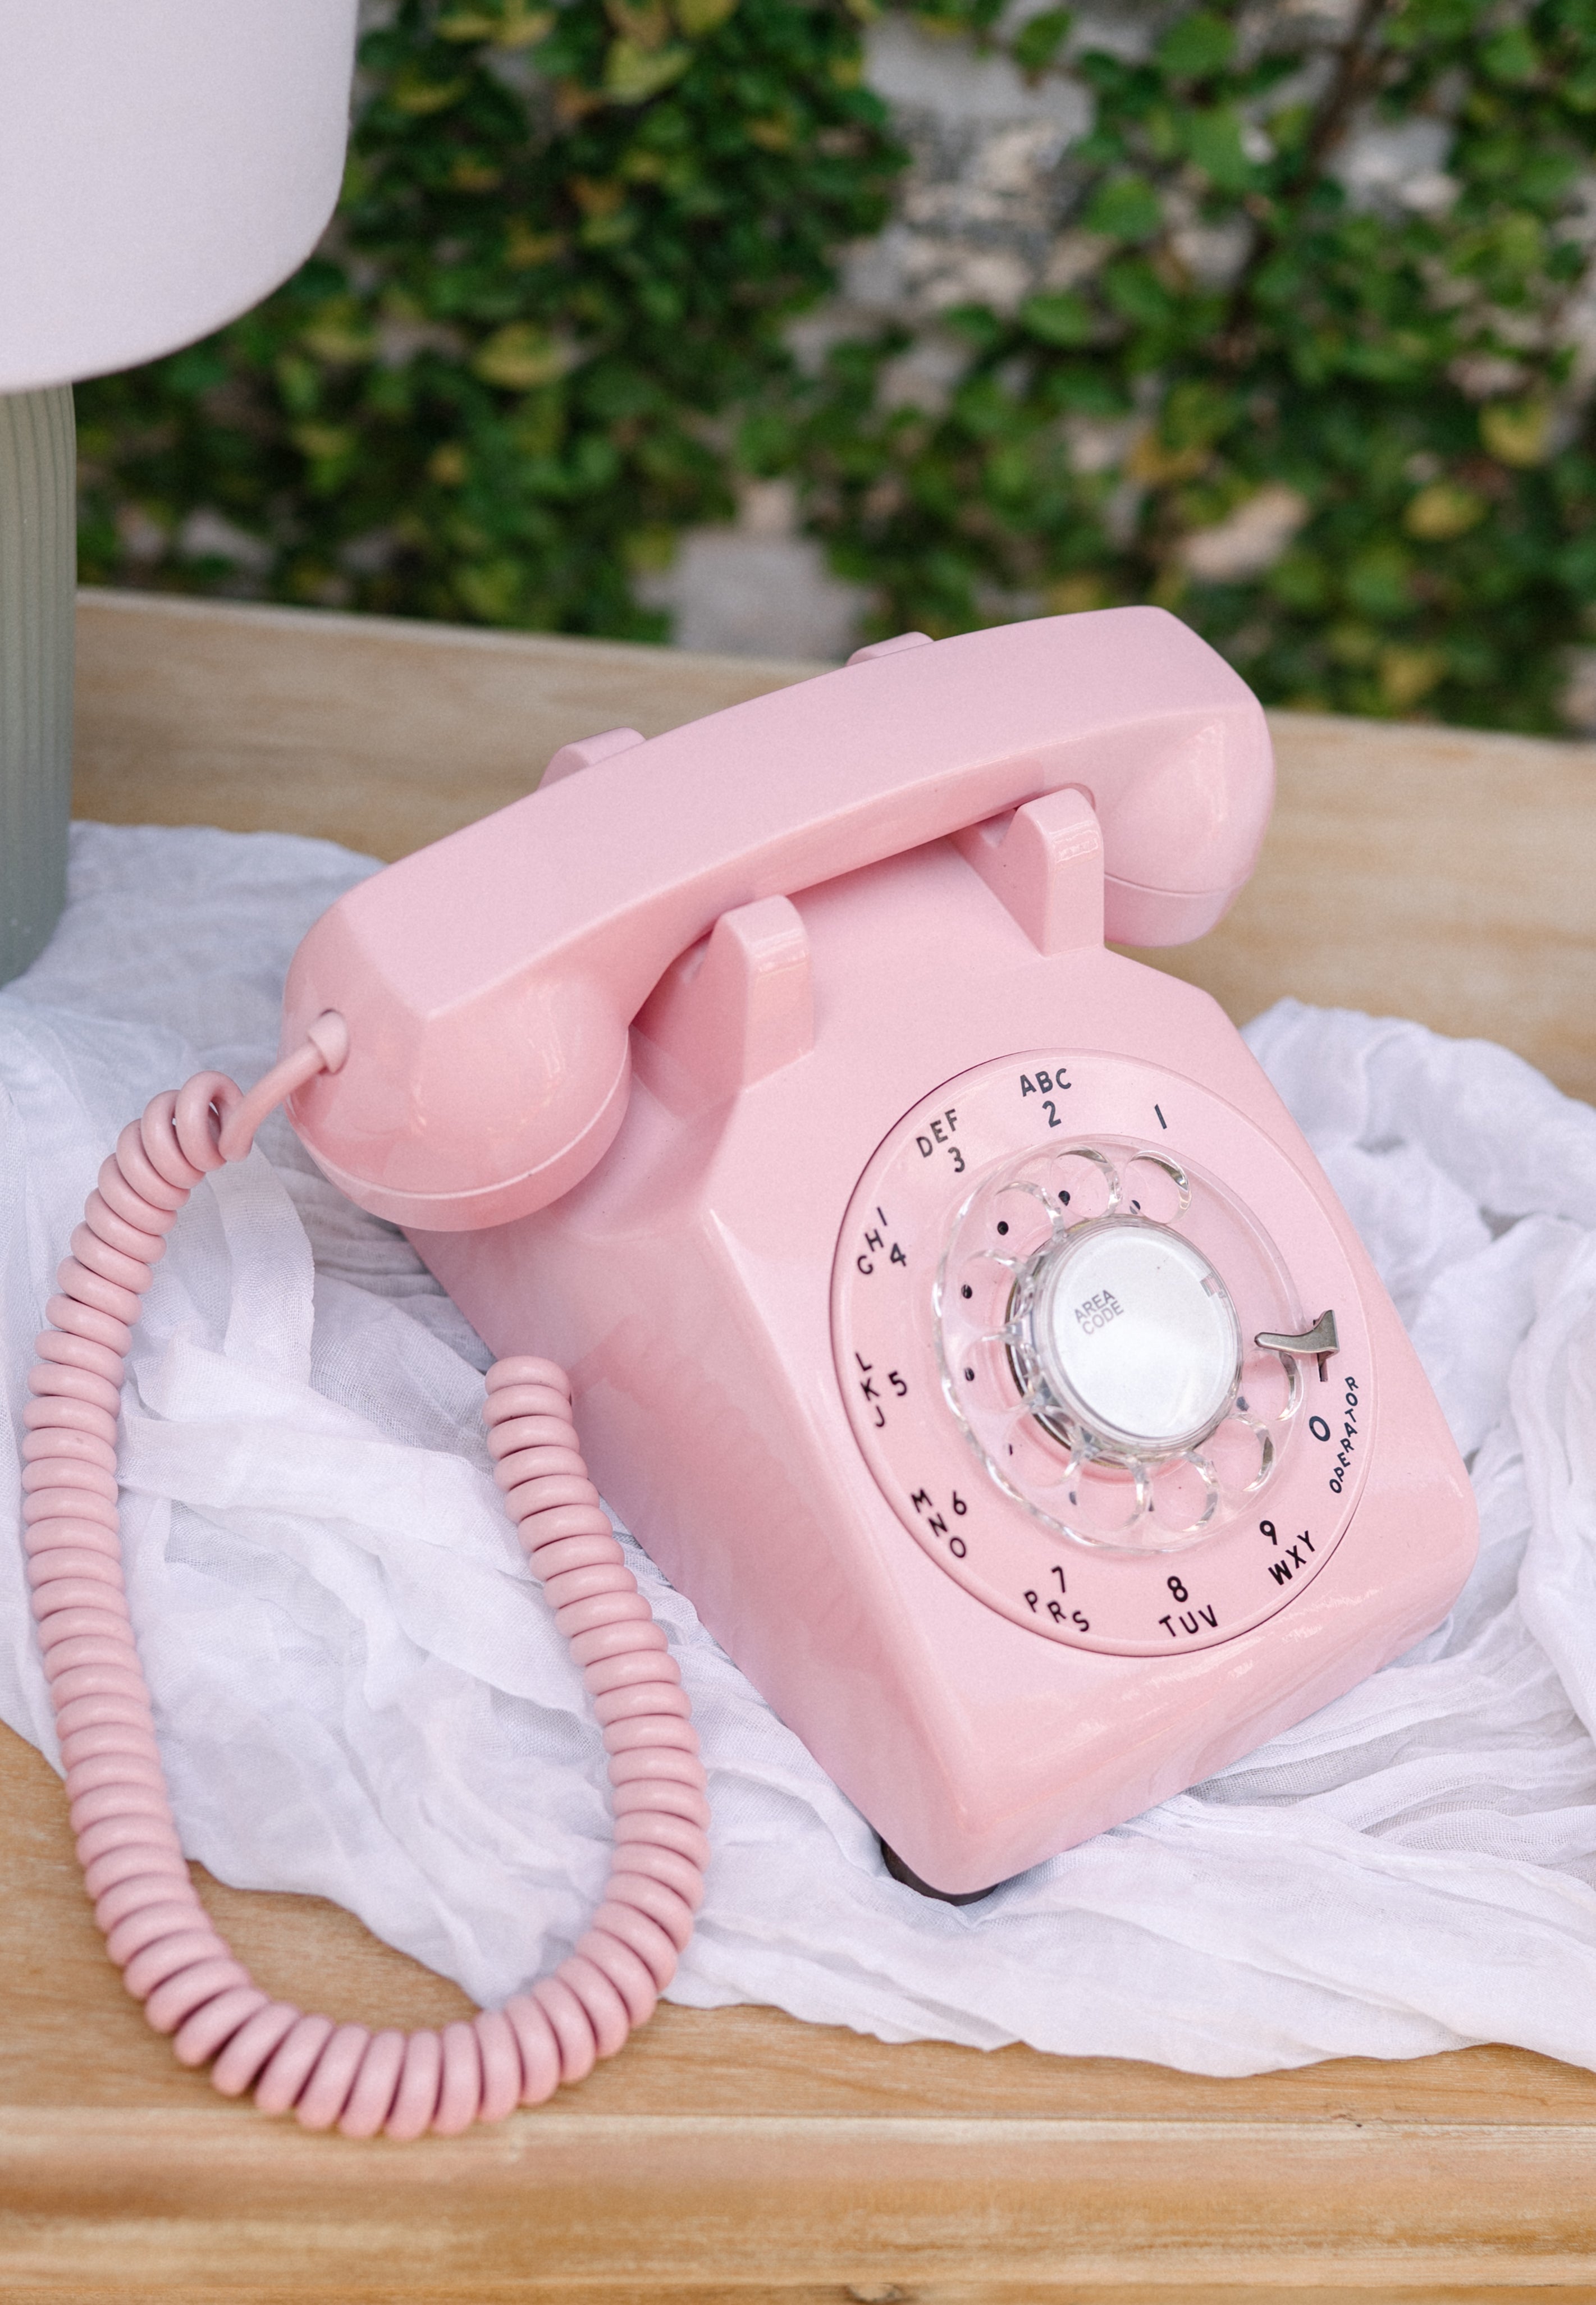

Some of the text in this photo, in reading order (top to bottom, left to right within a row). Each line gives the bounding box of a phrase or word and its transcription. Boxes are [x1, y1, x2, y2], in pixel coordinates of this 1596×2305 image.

[1019, 1068, 1072, 1097] ABC
[1042, 1100, 1062, 1128] 2
[916, 1109, 958, 1158] DEF
[948, 1147, 965, 1173] 3
[890, 1243, 907, 1267] 4
[1074, 1289, 1116, 1324] AREA
[1081, 1299, 1124, 1336] CODE
[888, 1371, 907, 1397] 5
[1309, 1416, 1330, 1442] 0
[1328, 1375, 1359, 1494] OPERATOR
[953, 1491, 967, 1516] 6
[911, 1488, 967, 1558] MNO
[1259, 1520, 1278, 1545] 9
[1267, 1530, 1316, 1586] WXY
[1051, 1566, 1066, 1593] 7
[1167, 1576, 1188, 1603] 8
[1023, 1590, 1090, 1632] PRS
[1158, 1604, 1219, 1637] TUV
